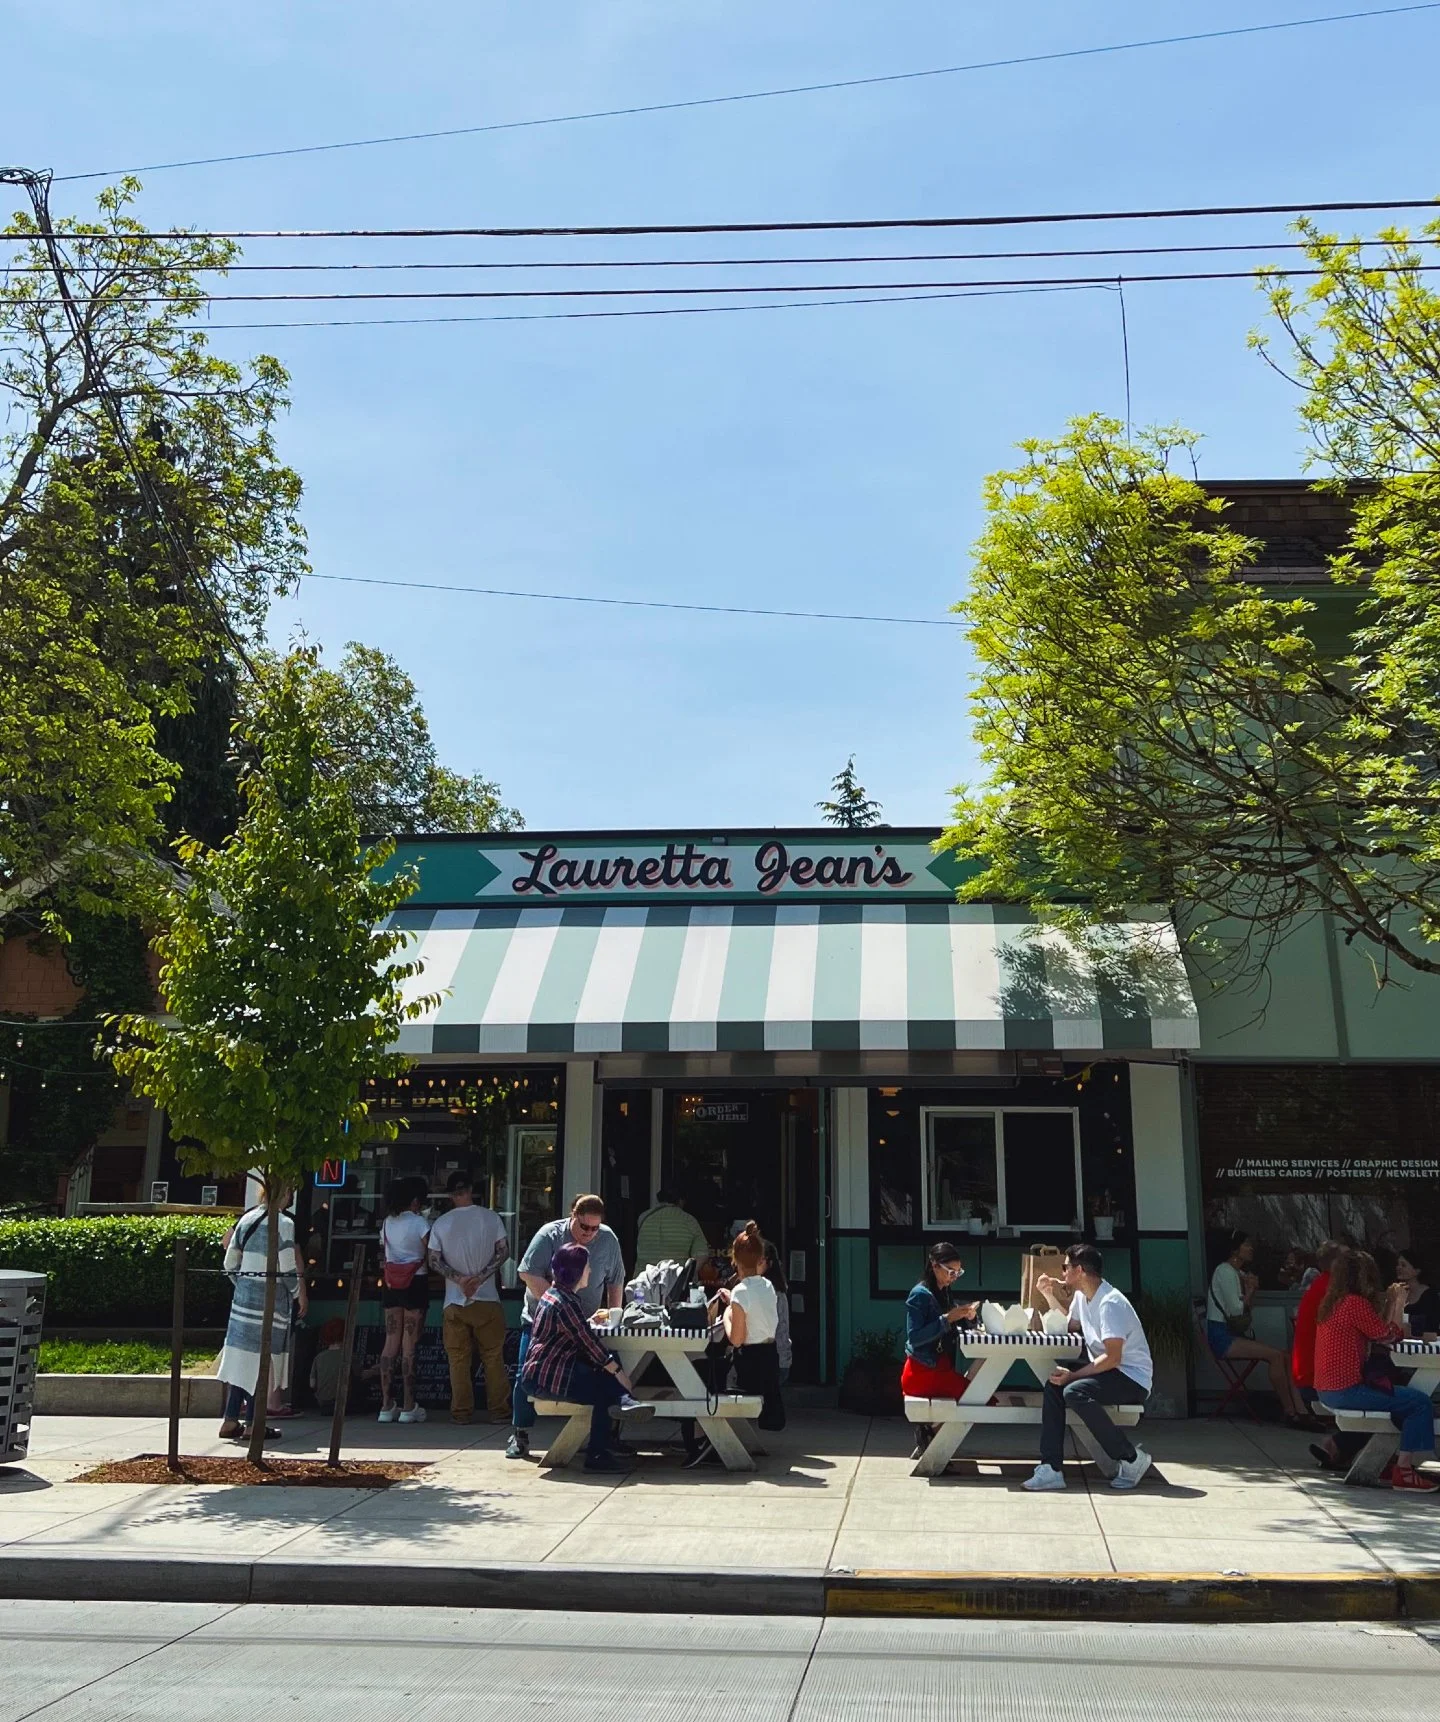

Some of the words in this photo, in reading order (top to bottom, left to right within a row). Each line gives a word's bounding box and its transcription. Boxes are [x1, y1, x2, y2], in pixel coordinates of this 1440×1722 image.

[512, 843, 734, 895] Lauretta
[754, 840, 915, 894] Jean's
[695, 1104, 739, 1118] ORDER
[1247, 1159, 1289, 1168] MAILING
[1291, 1159, 1340, 1168] SERVICES
[1353, 1159, 1398, 1168] GRAPHIC
[1400, 1159, 1439, 1168] DESIGN
[1227, 1169, 1276, 1177] BUSINESS
[1278, 1169, 1313, 1177] CARDS
[1326, 1169, 1372, 1177] POSTERS
